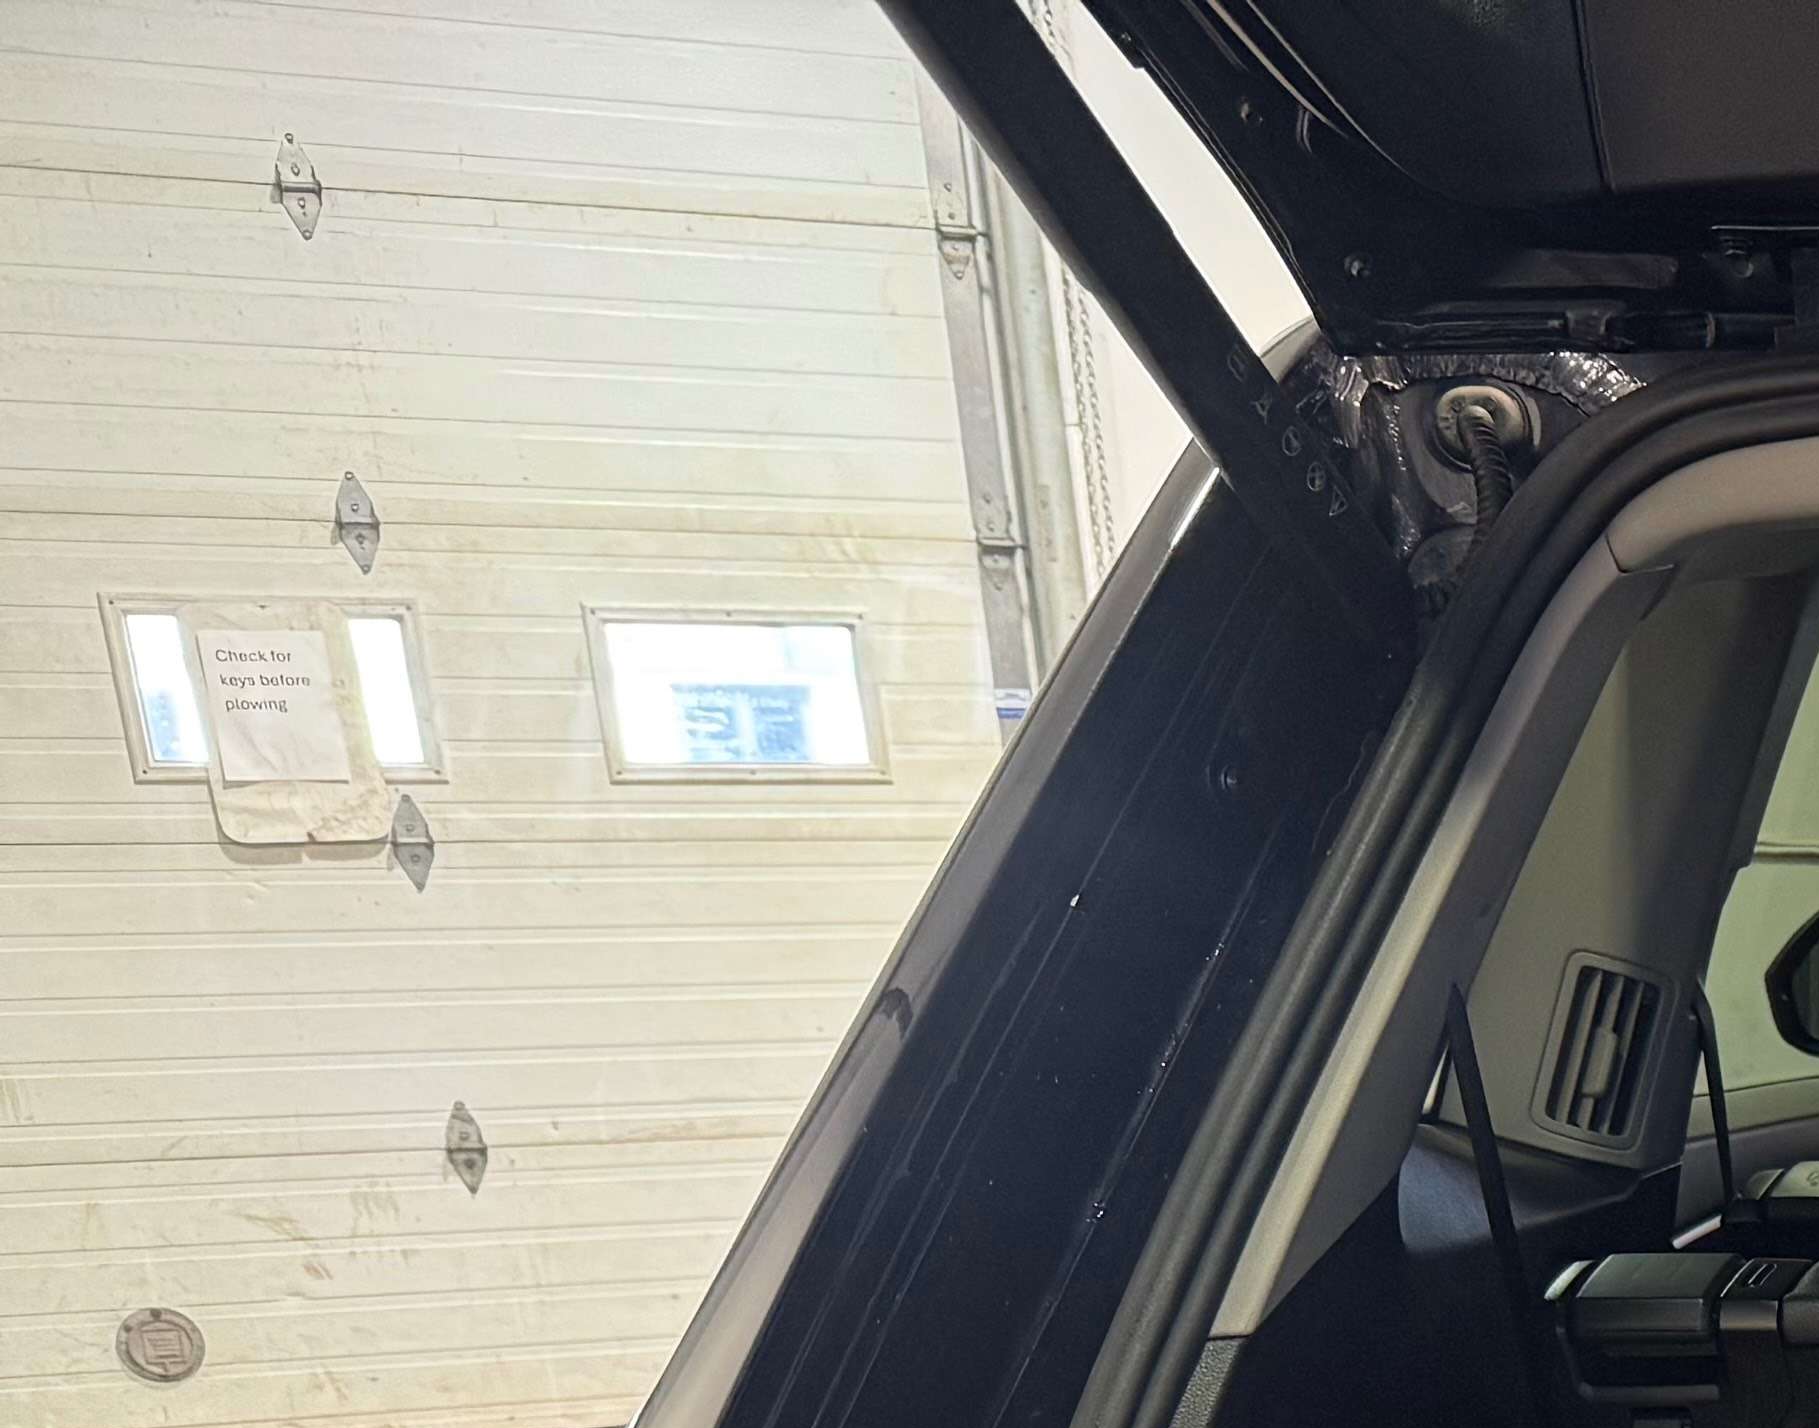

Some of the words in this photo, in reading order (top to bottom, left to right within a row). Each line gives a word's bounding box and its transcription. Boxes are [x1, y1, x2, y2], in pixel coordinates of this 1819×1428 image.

[215, 649, 268, 662] Check
[270, 650, 291, 662] for
[219, 673, 256, 688] keys
[259, 674, 310, 687] before
[225, 698, 288, 713] plowing
